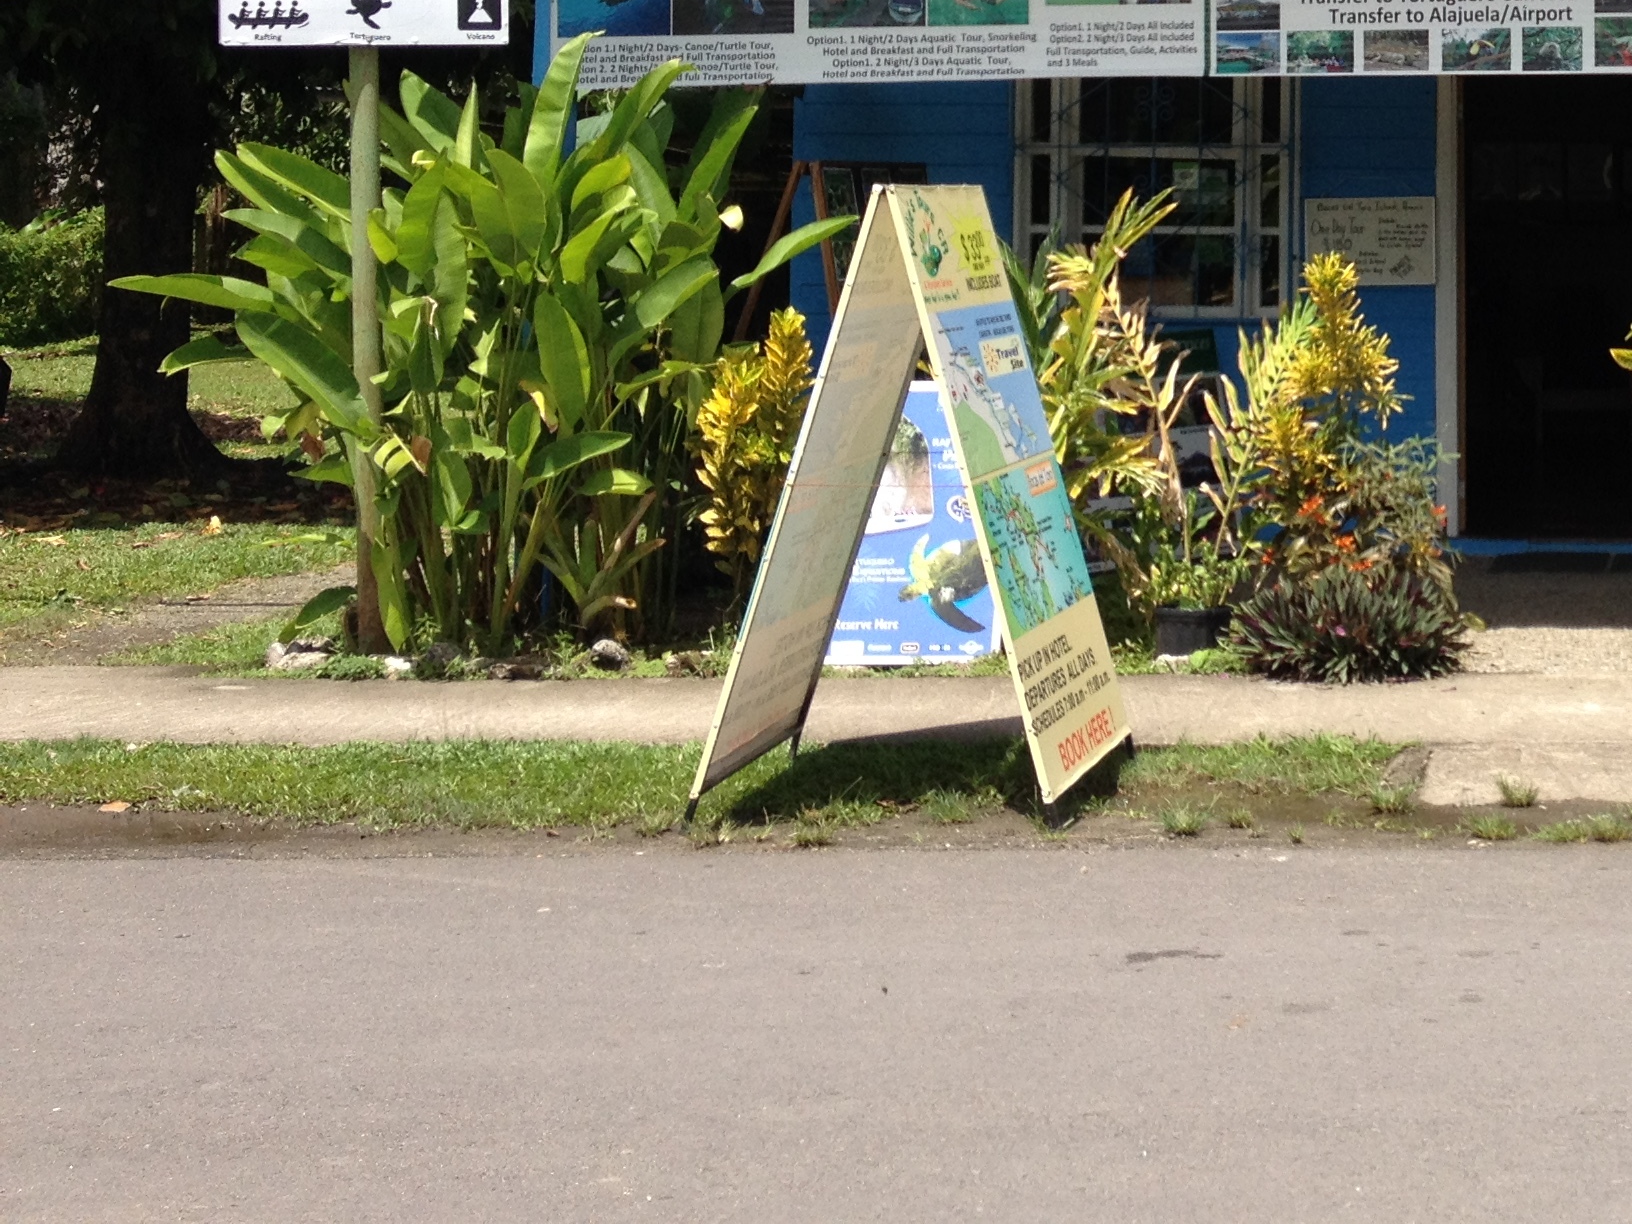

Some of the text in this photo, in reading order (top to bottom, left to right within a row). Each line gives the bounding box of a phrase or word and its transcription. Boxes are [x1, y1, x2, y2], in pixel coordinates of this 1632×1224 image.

[1329, 5, 1572, 26] Transfer to Alajuela/Airport
[858, 33, 893, 46] Night/2
[897, 33, 918, 45] Days
[921, 32, 956, 44] Aquatic
[989, 31, 1036, 44] Snorkeling
[823, 44, 1025, 56] Hotel and Breakfast and Full Transportation
[996, 345, 1019, 361] Travel
[1017, 656, 1035, 682] PICK
[1031, 650, 1044, 673] UP
[1024, 666, 1067, 712] DEPARTURES
[1067, 656, 1081, 682] ALL
[1058, 709, 1112, 771] BOOK HERE
